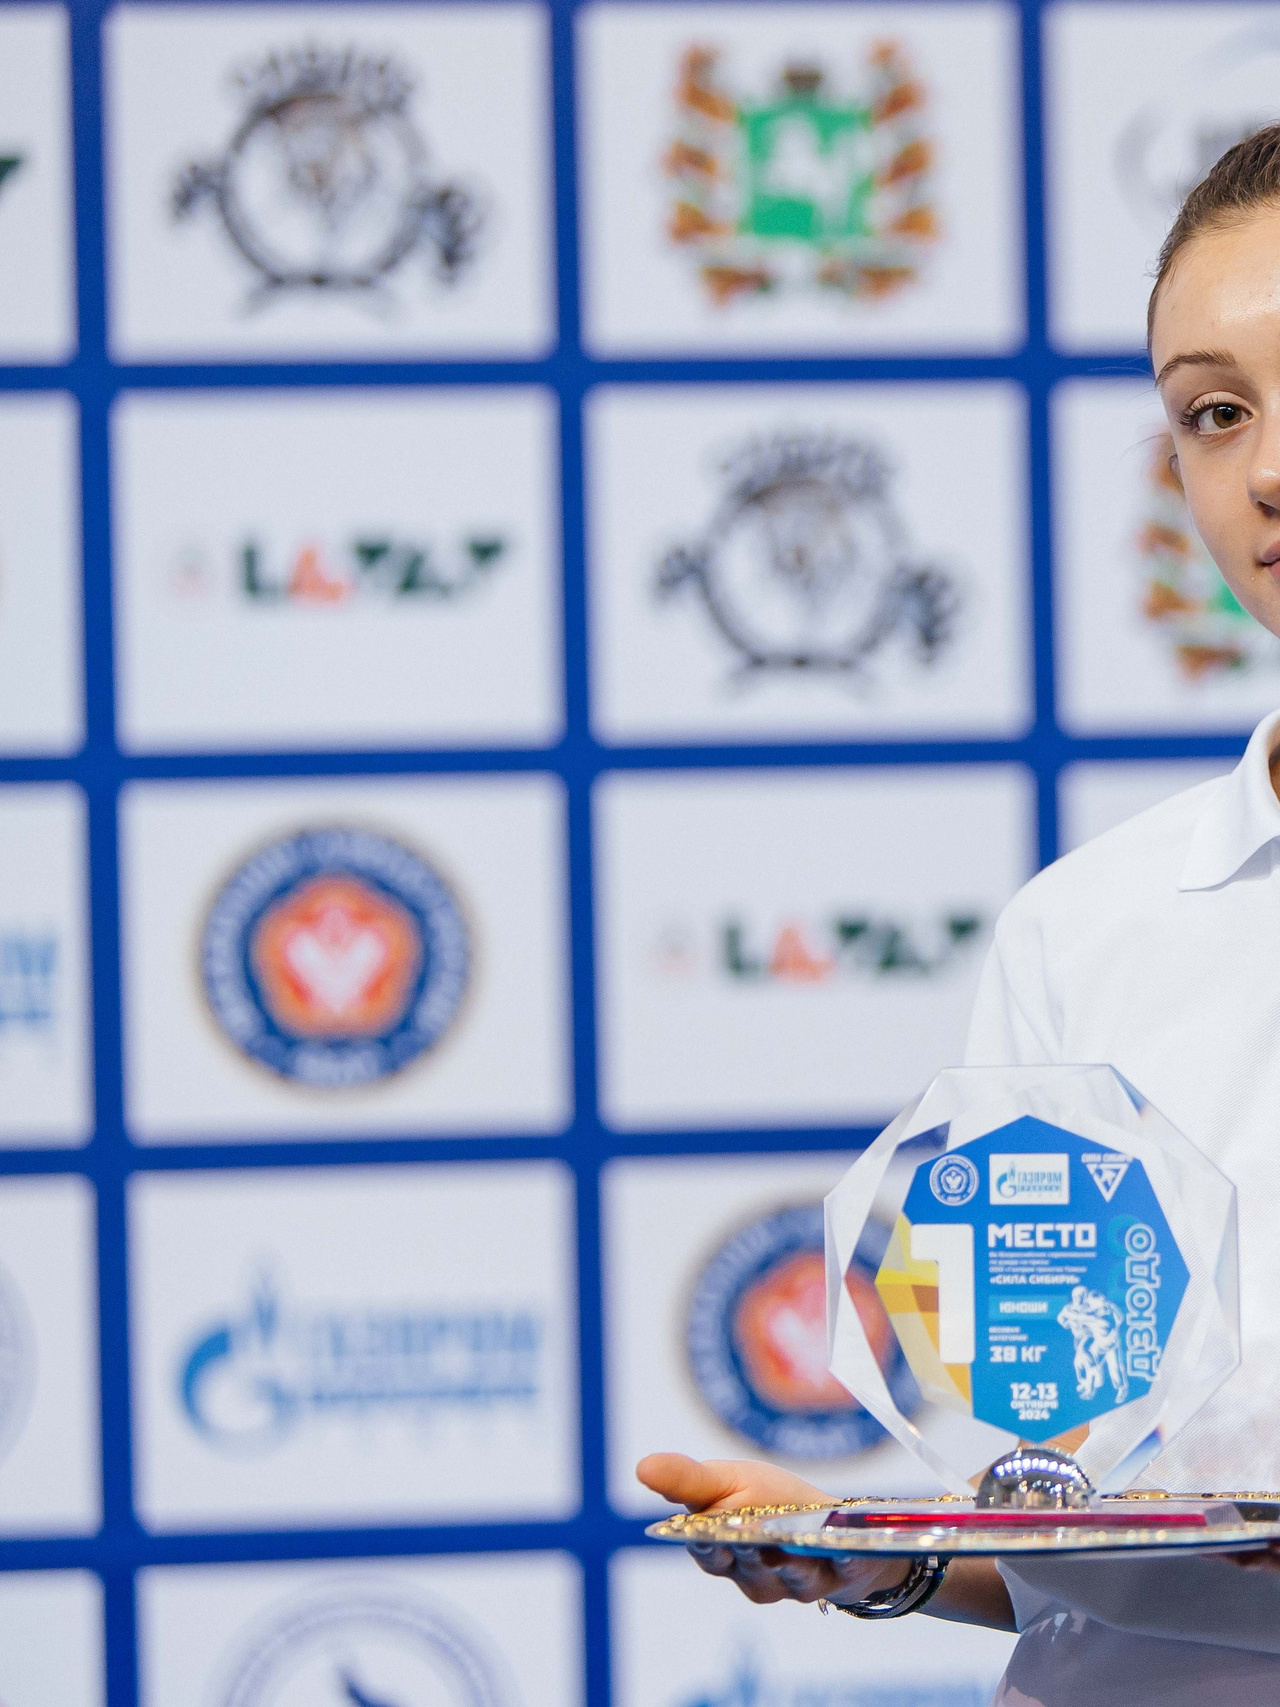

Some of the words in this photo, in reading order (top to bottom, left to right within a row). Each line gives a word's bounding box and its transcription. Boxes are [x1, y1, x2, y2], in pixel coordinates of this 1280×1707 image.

[987, 1222, 1097, 1249] МЕСТО
[989, 1274, 1027, 1285] «СИЛА
[1028, 1274, 1081, 1285] СИБИРИ»
[910, 1223, 976, 1364] 1
[1124, 1223, 1162, 1382] ДЗЮДО
[999, 1301, 1048, 1314] ЮНОШИ
[1020, 1345, 1048, 1363] КГ
[1009, 1382, 1059, 1400] 12-13
[1018, 1409, 1050, 1421] 2024
